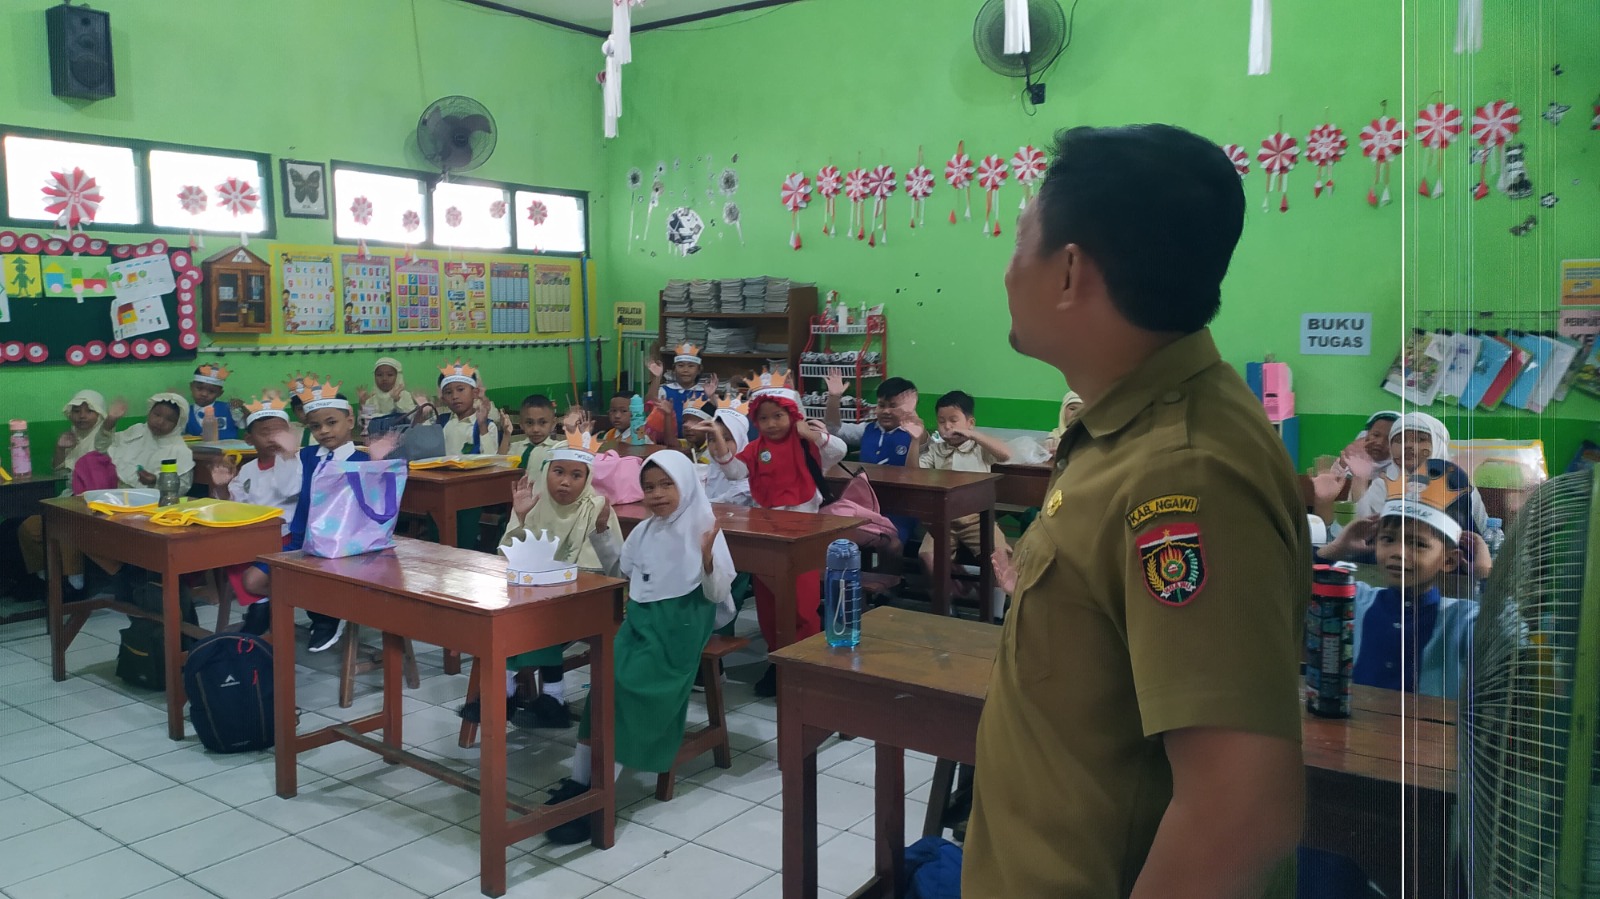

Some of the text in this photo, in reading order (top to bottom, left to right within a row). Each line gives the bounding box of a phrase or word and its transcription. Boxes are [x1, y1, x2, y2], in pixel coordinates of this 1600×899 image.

[1308, 318, 1364, 331] BUKU
[1307, 335, 1363, 348] TUGAS
[1156, 499, 1195, 511] NGAWI
